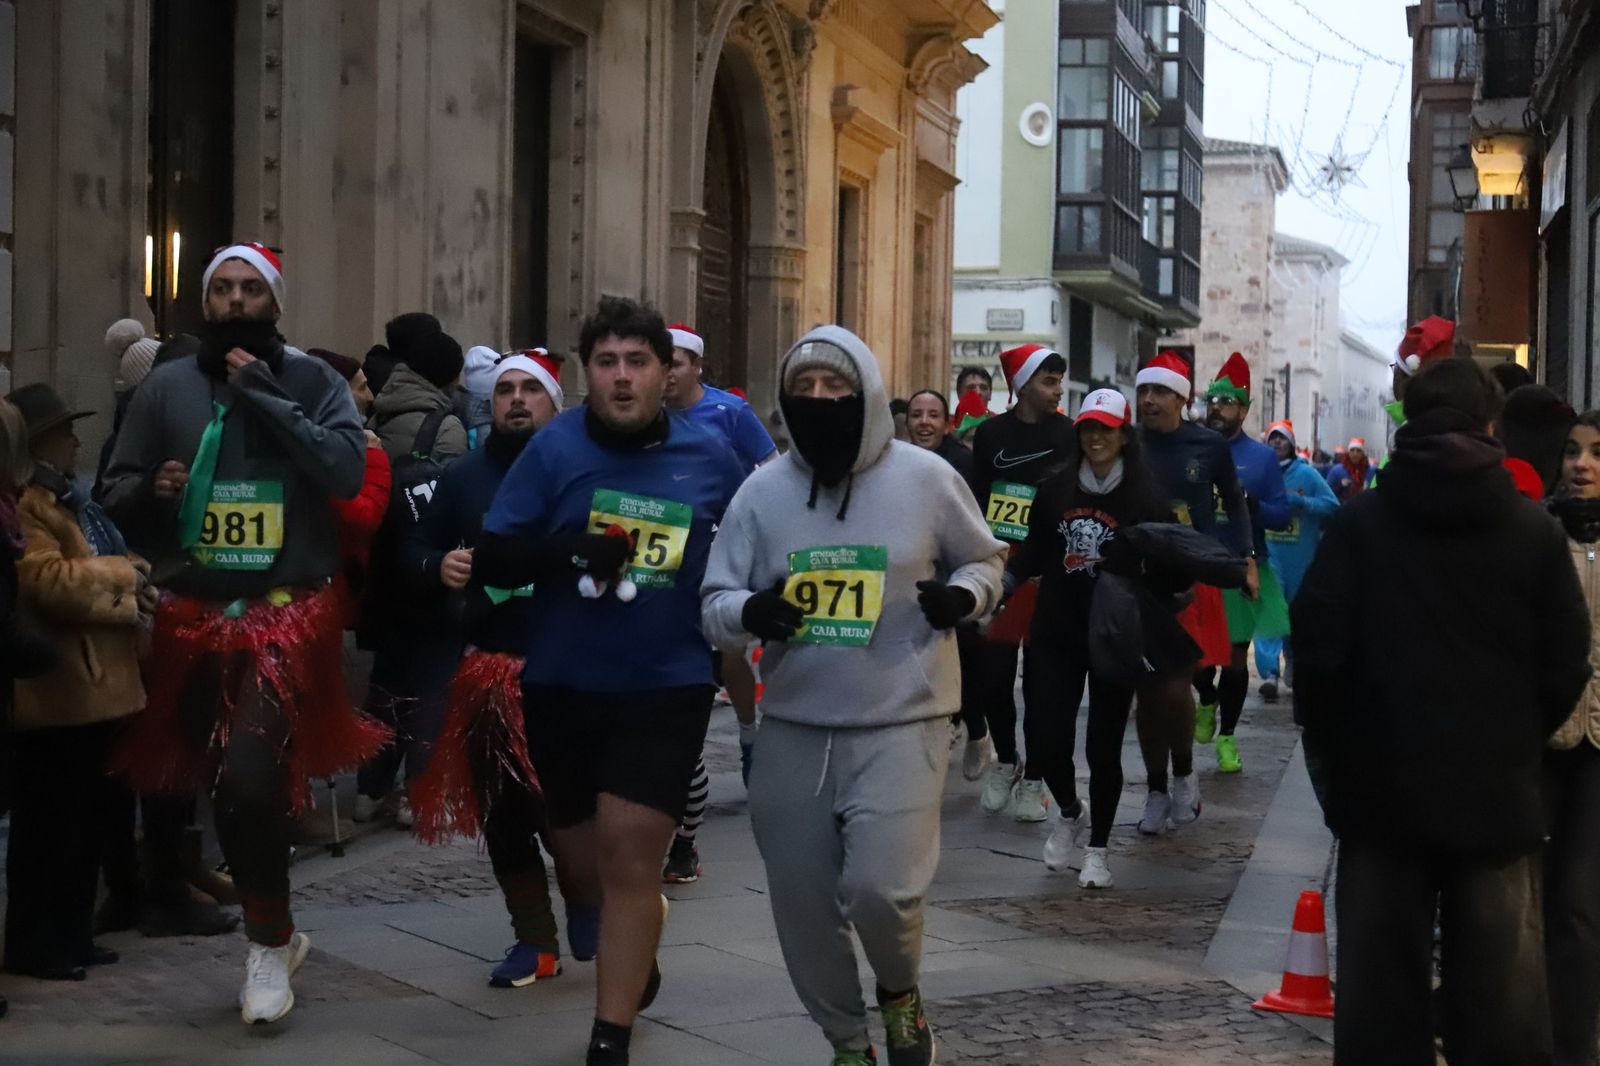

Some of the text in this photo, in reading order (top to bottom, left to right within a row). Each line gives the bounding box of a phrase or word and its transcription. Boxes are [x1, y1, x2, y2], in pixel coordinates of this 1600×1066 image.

[619, 504, 637, 513] CAJA
[639, 507, 664, 518] RURAL
[993, 500, 1032, 526] 720
[199, 511, 264, 546] 981
[215, 553, 240, 563] CAJA
[810, 557, 829, 565] CAJA
[636, 573, 670, 584] RURAL
[795, 579, 864, 618] 971
[812, 625, 837, 637] CAJA
